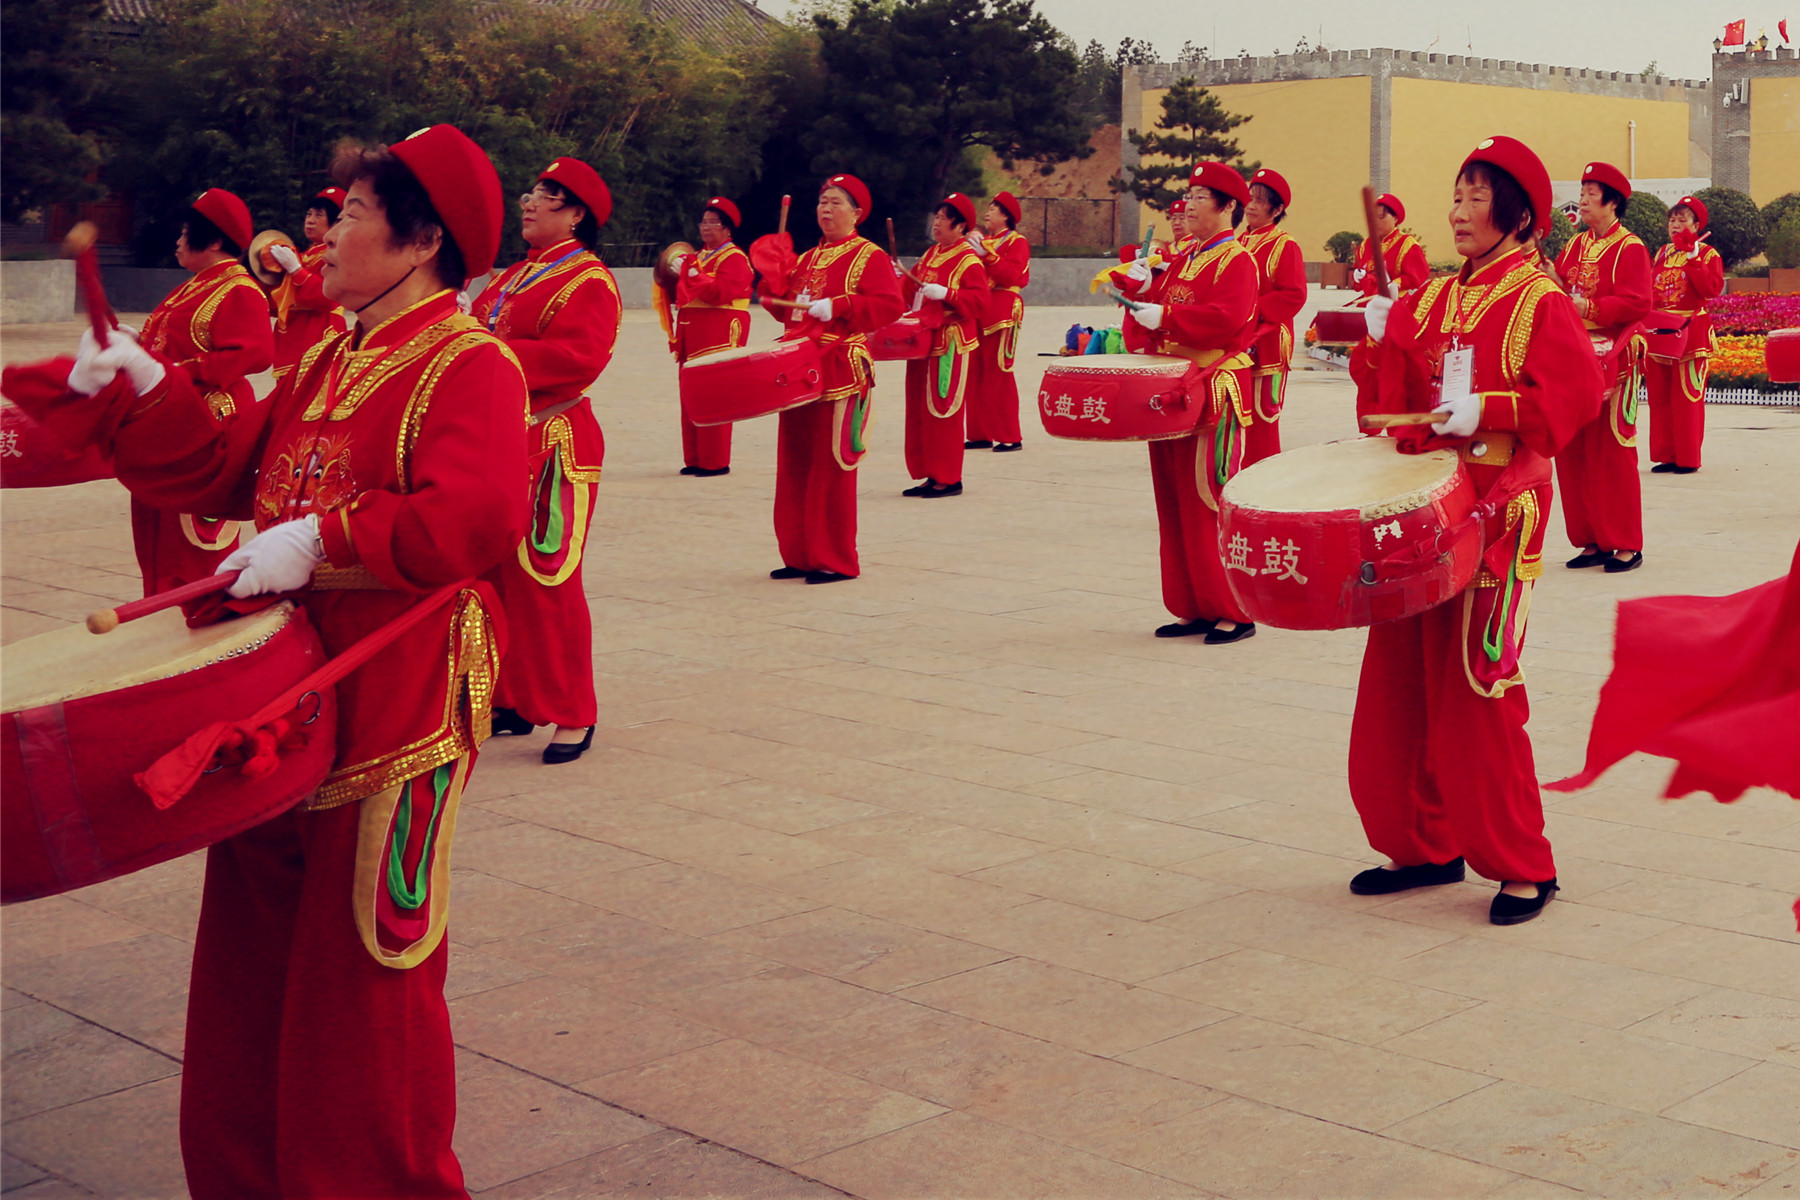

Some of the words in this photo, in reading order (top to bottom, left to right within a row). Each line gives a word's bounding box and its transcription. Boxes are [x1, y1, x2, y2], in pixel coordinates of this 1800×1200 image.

[1040, 390, 1111, 424] 飞盘鼓
[1220, 531, 1308, 585] 盘鼓
